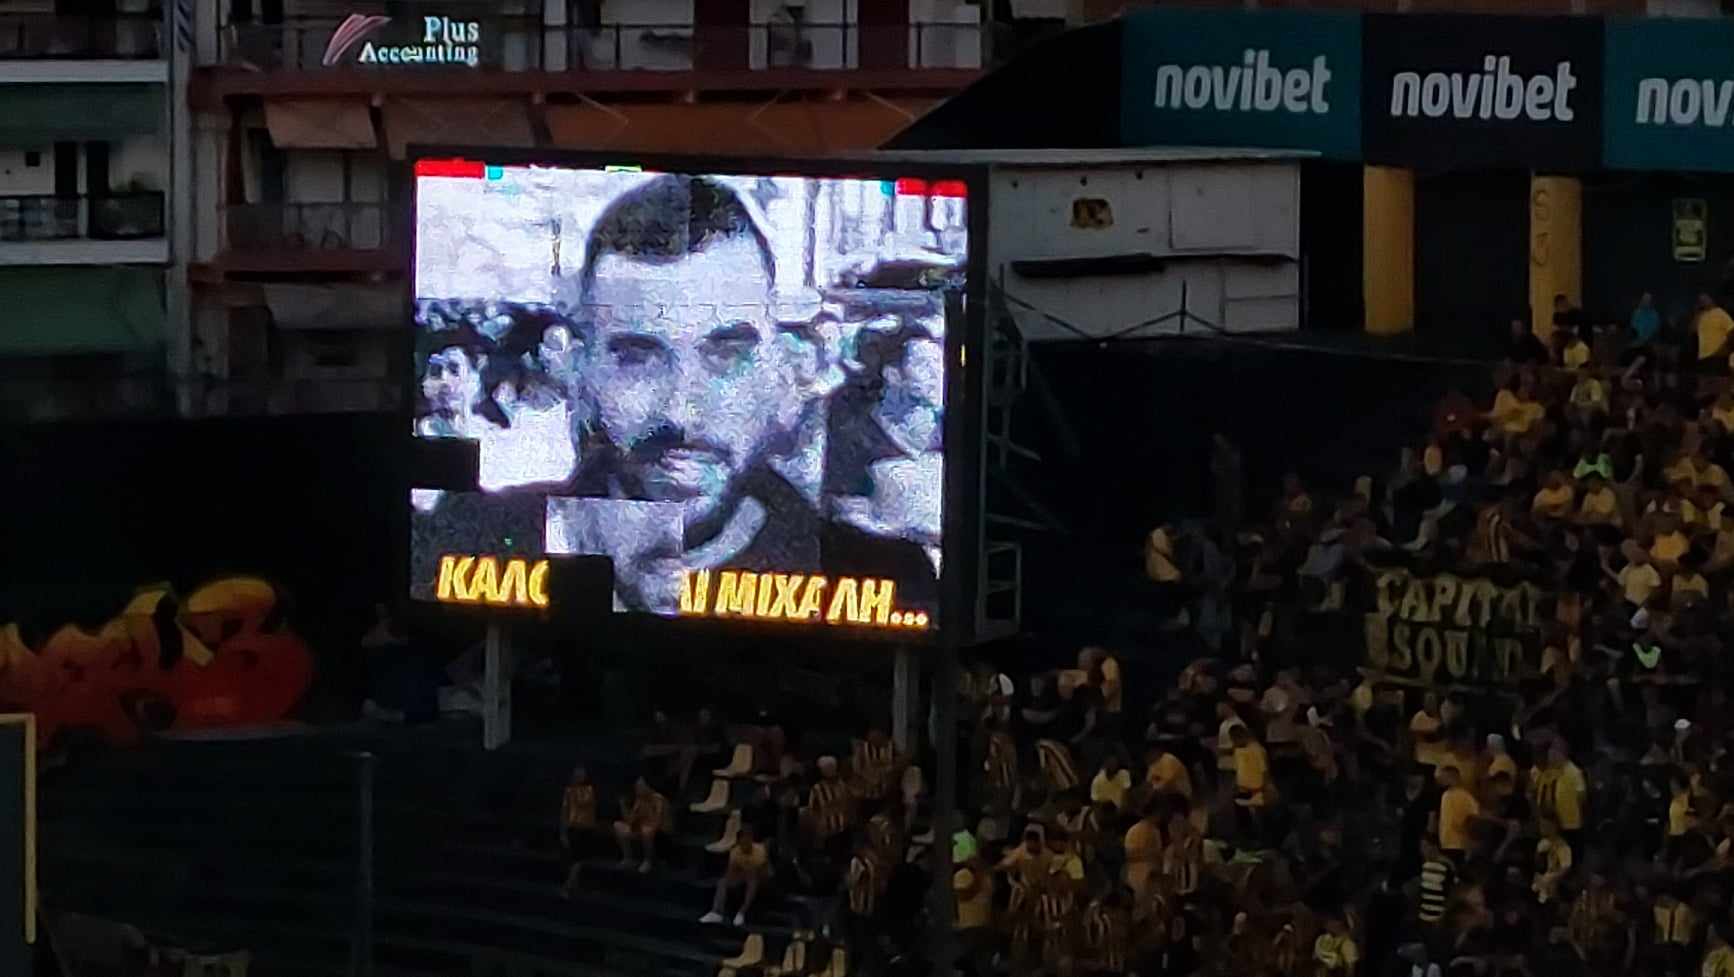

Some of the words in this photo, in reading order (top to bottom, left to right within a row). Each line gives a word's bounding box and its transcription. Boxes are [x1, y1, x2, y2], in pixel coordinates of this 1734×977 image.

[423, 15, 480, 43] Plus
[358, 41, 479, 67] Accounting
[1154, 49, 1331, 114] novibet
[1390, 54, 1577, 122] novibet
